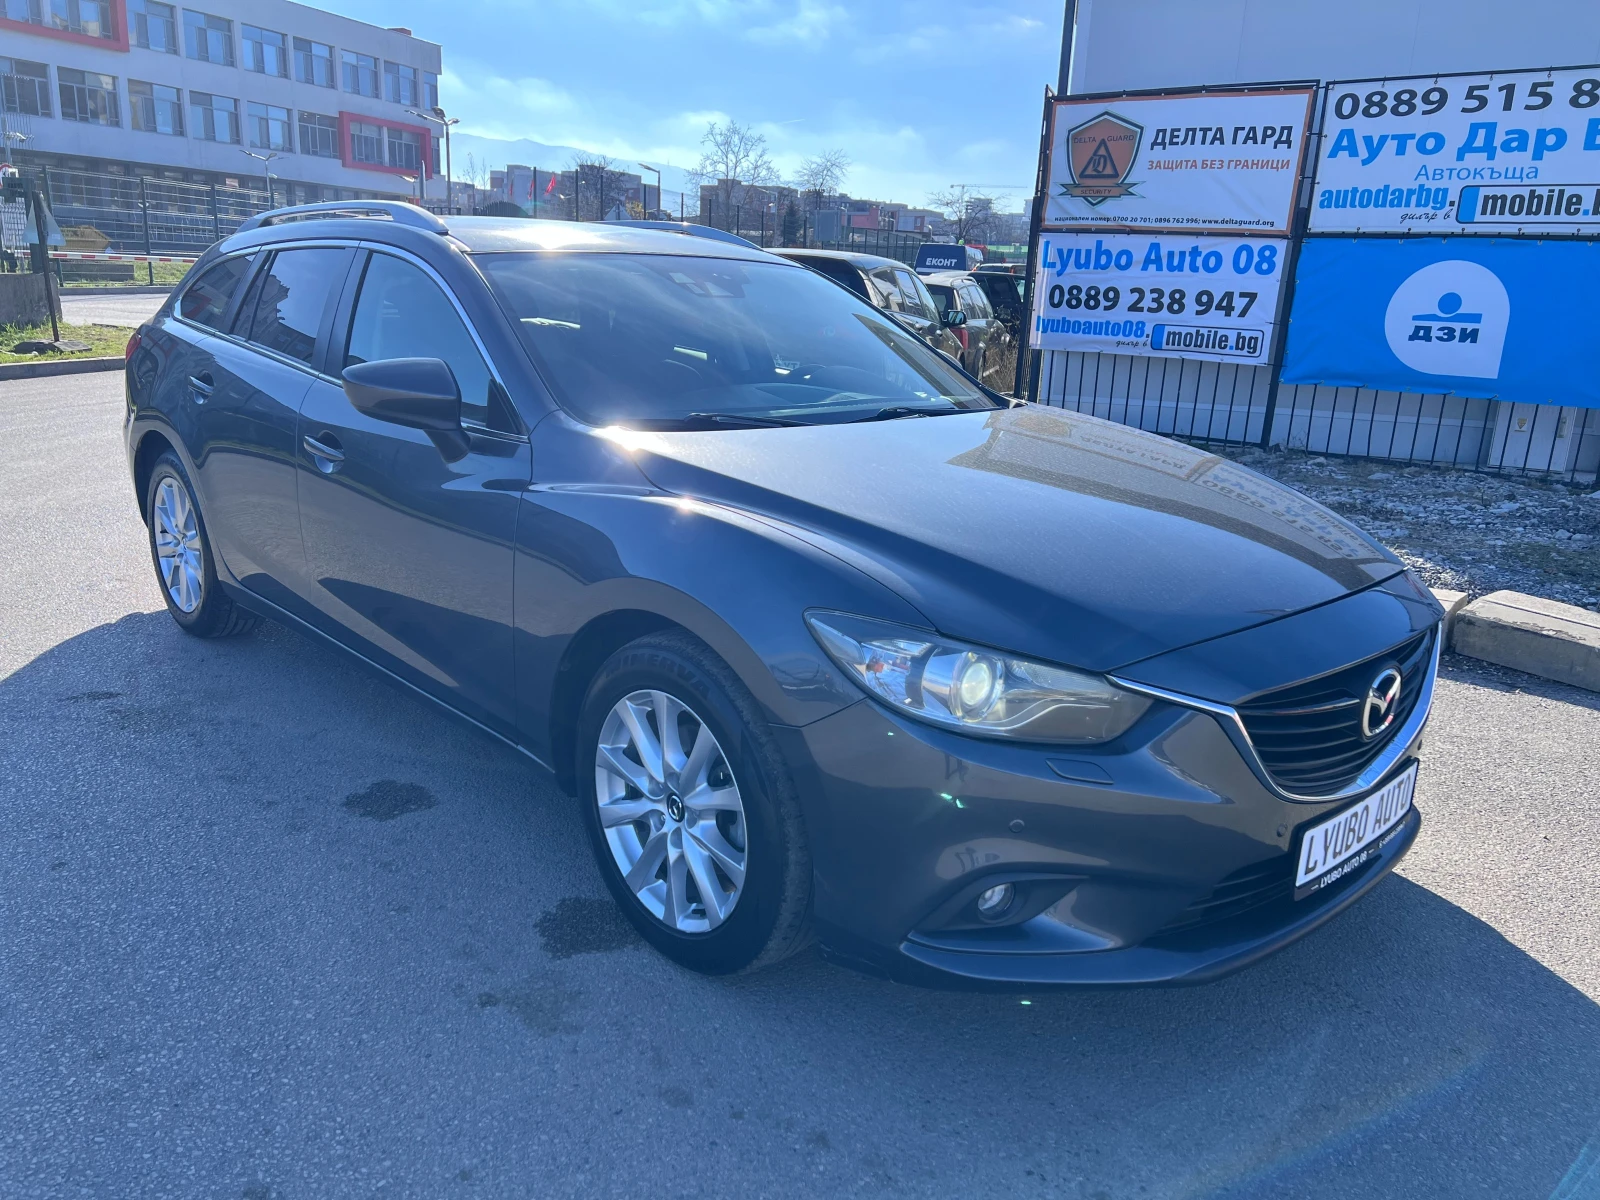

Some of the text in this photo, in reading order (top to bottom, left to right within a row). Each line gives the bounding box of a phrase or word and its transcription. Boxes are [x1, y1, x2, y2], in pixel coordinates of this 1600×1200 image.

[1334, 78, 1600, 120] 0889 515 8
[1073, 134, 1135, 144] DELTA GUARD
[1150, 125, 1293, 150] ДЕЛТА ГАРД
[1327, 128, 1446, 167] Ауто
[1456, 121, 1567, 162] Дар
[1148, 158, 1290, 172] ЗАЩИТА БЕЗ ГРАНИЦИ
[1414, 164, 1539, 183] Автокъща
[1201, 217, 1275, 227] www.deltaguard.org
[925, 257, 957, 267] ЕКОНТ
[1042, 240, 1278, 277] Lyubo Auto 08
[1049, 283, 1258, 318] 0889 238 947
[1166, 328, 1259, 354] mobile.bg
[1408, 325, 1480, 344] ДЗИ
[1304, 804, 1370, 876] LYUBO
[1372, 773, 1411, 834] AUTO
